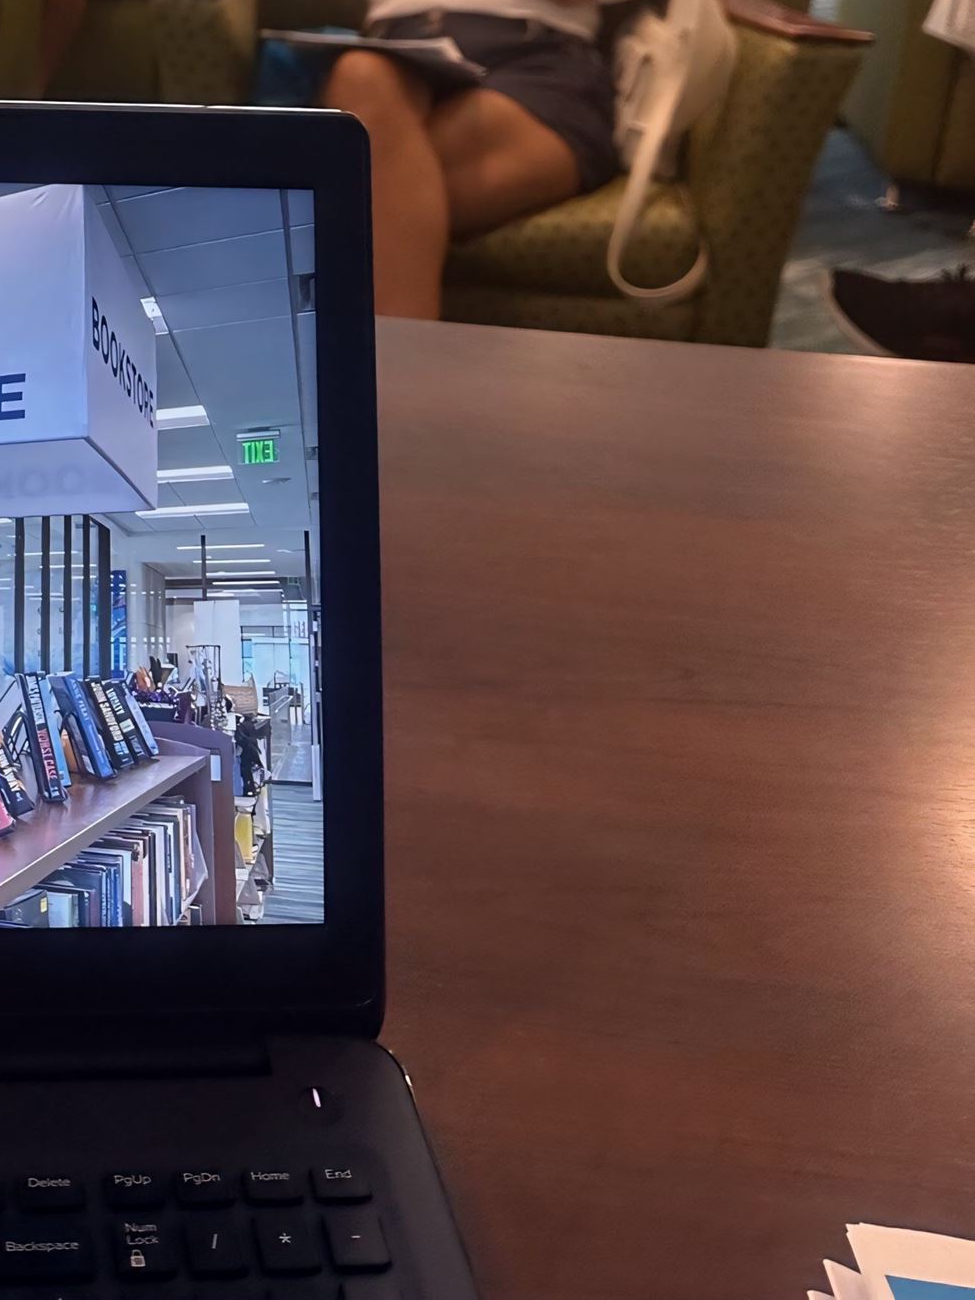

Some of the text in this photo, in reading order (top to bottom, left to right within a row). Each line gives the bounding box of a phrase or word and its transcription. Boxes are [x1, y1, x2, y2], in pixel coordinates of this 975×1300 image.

[92, 297, 154, 428] BOOKSTORE
[183, 1171, 221, 1185] PgDn
[251, 1170, 291, 1182] Home
[325, 1168, 353, 1180] End
[28, 1176, 71, 1188] Delete
[114, 1174, 152, 1187] PgUp
[126, 1222, 158, 1233] Num
[126, 1234, 159, 1246] Lock
[5, 1240, 79, 1253] Backspace
